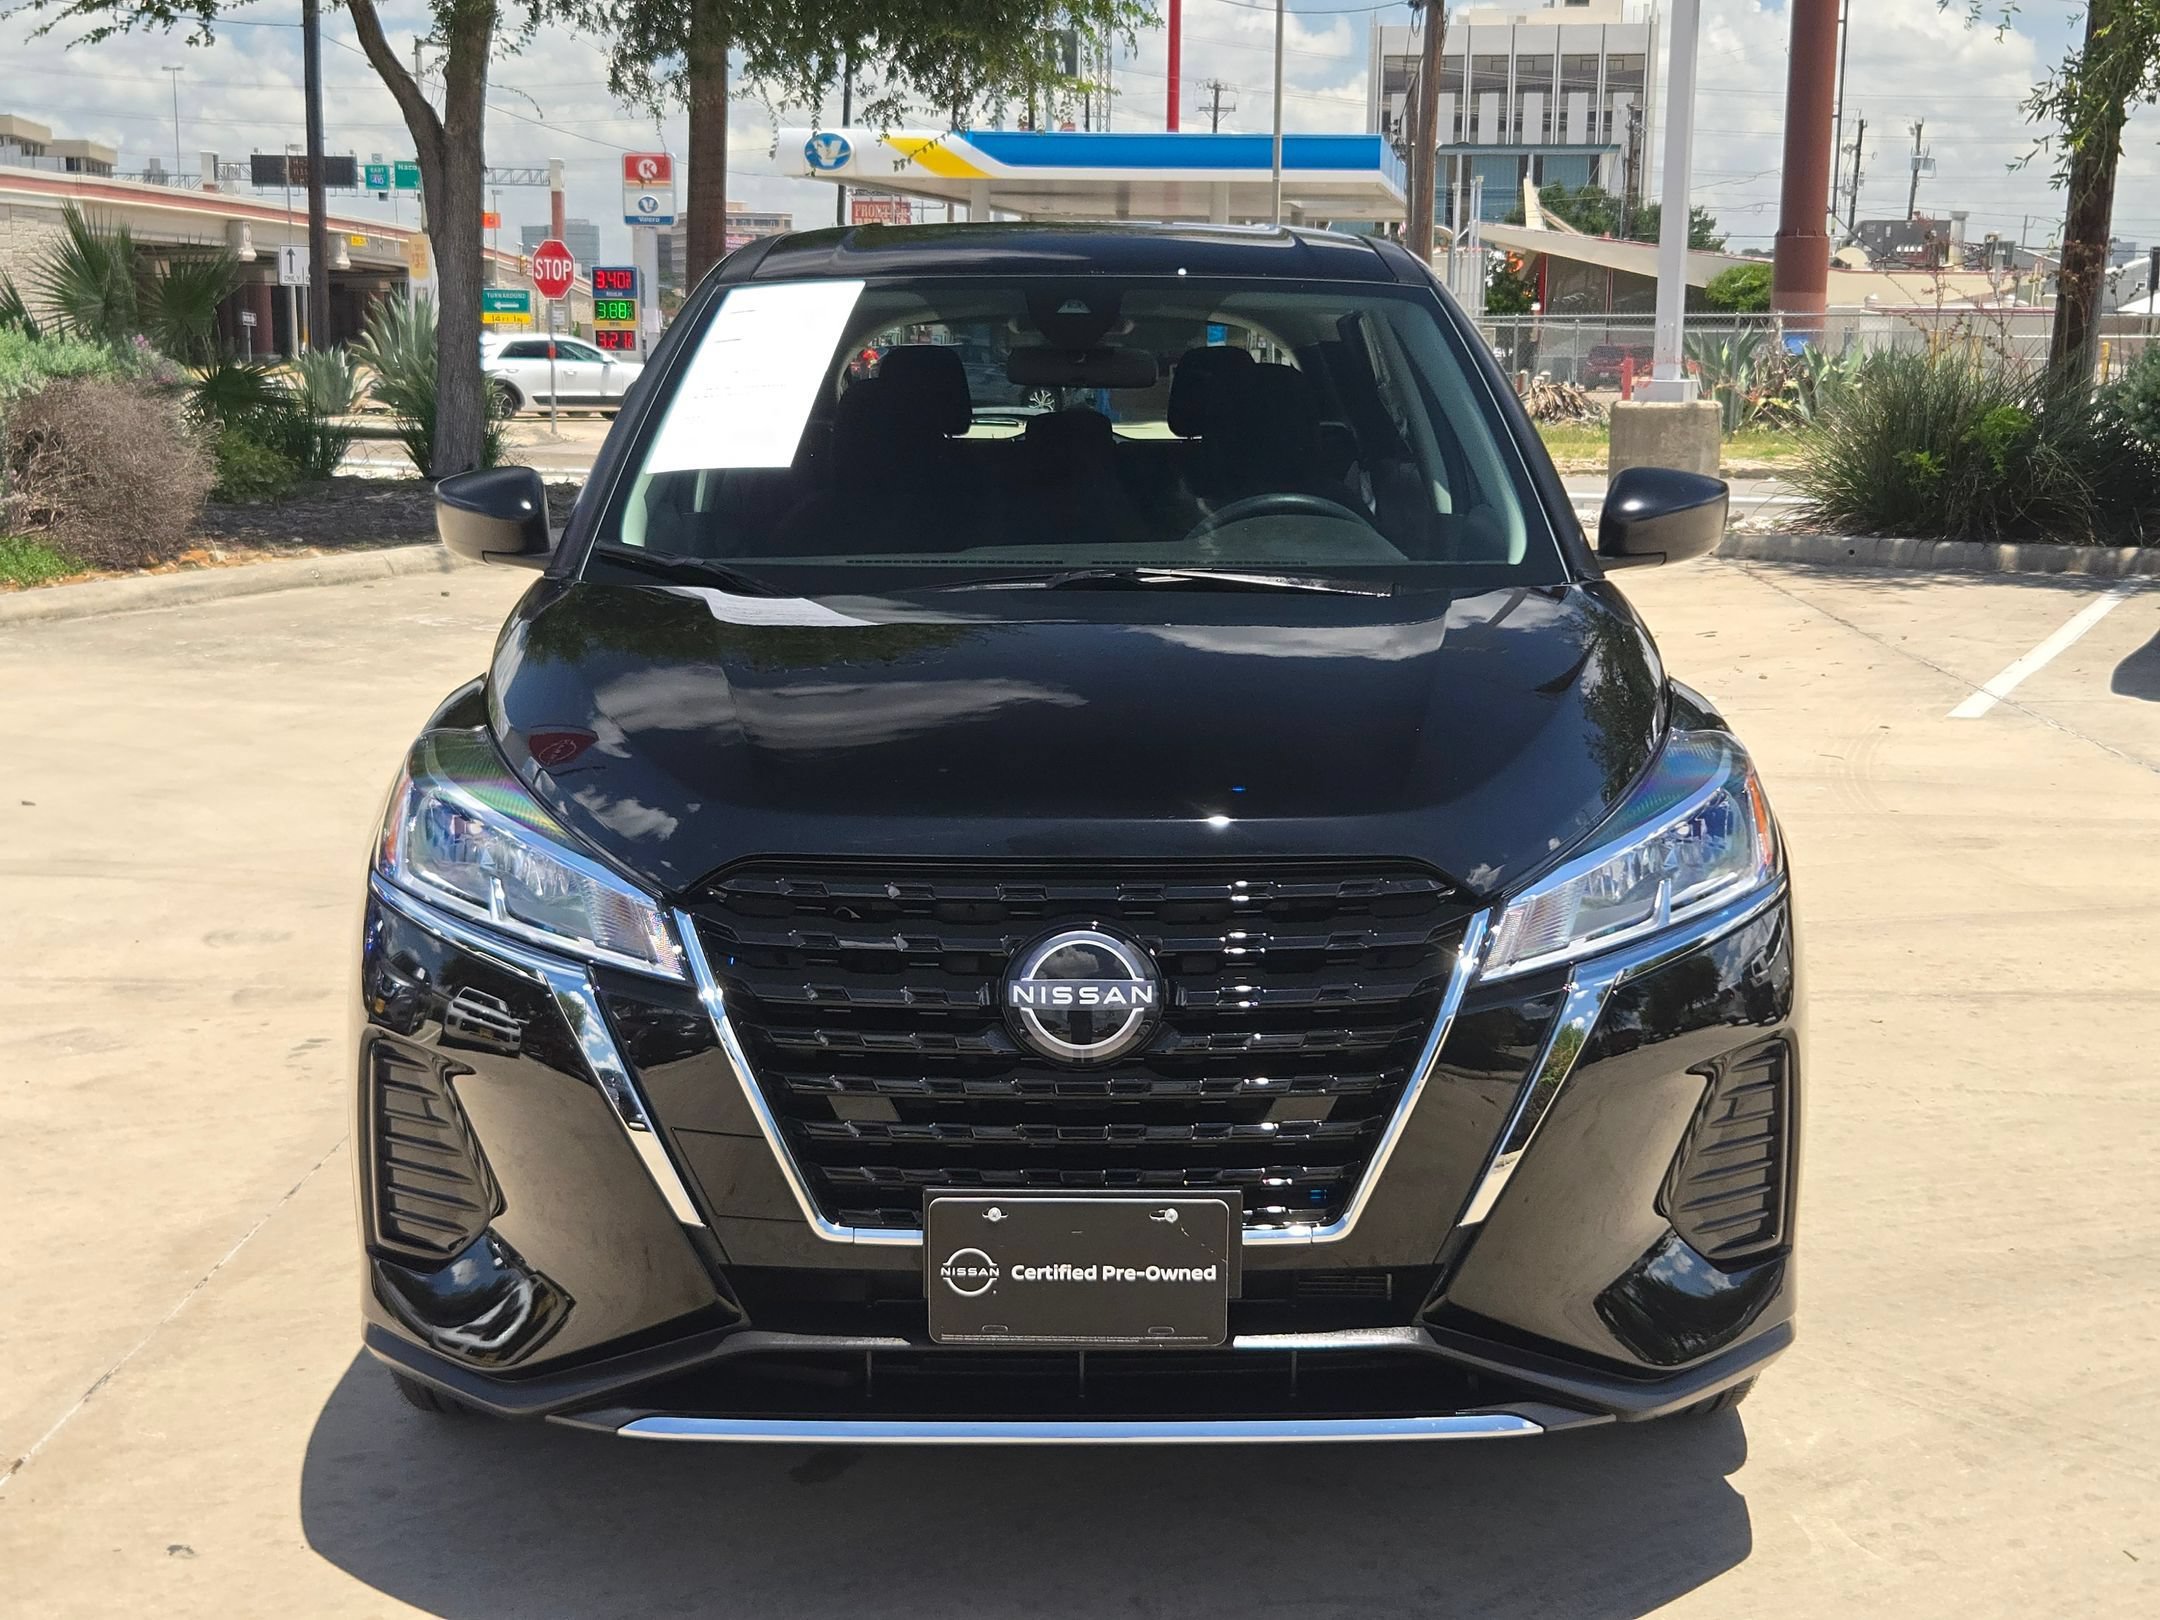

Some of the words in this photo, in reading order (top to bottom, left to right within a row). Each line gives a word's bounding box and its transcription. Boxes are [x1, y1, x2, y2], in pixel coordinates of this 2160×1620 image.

[535, 259, 572, 281] STOP
[1013, 985, 1153, 1005] NISSAN
[941, 1267, 1000, 1277] NISSAN
[1011, 1264, 1098, 1281] Certified
[1102, 1265, 1217, 1282] Pre-Owned
